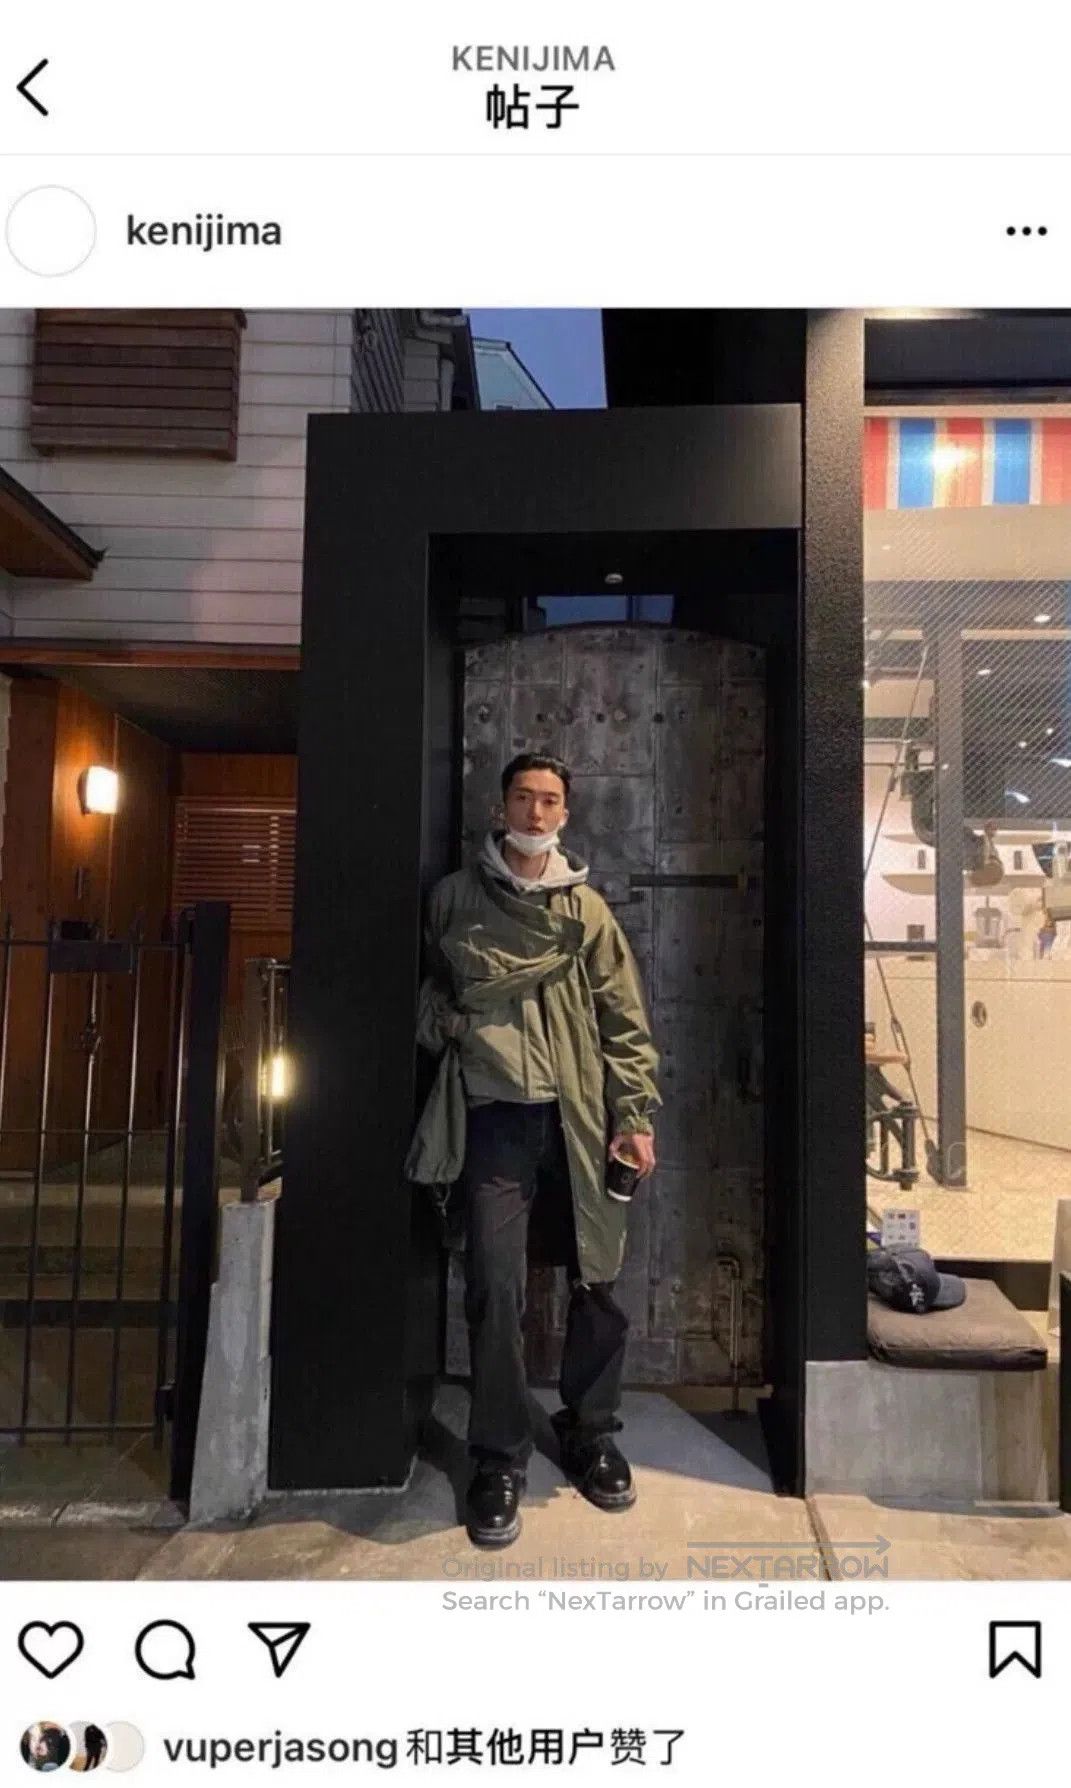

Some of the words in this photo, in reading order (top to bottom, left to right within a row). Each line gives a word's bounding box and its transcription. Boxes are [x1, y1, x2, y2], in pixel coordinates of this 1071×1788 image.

[452, 45, 616, 72] KENIJIMA
[485, 83, 580, 130] 帖子
[127, 213, 282, 253] kenijima
[163, 1732, 398, 1769] vuperjasong
[406, 1727, 685, 1766] 和其他用户赞了
